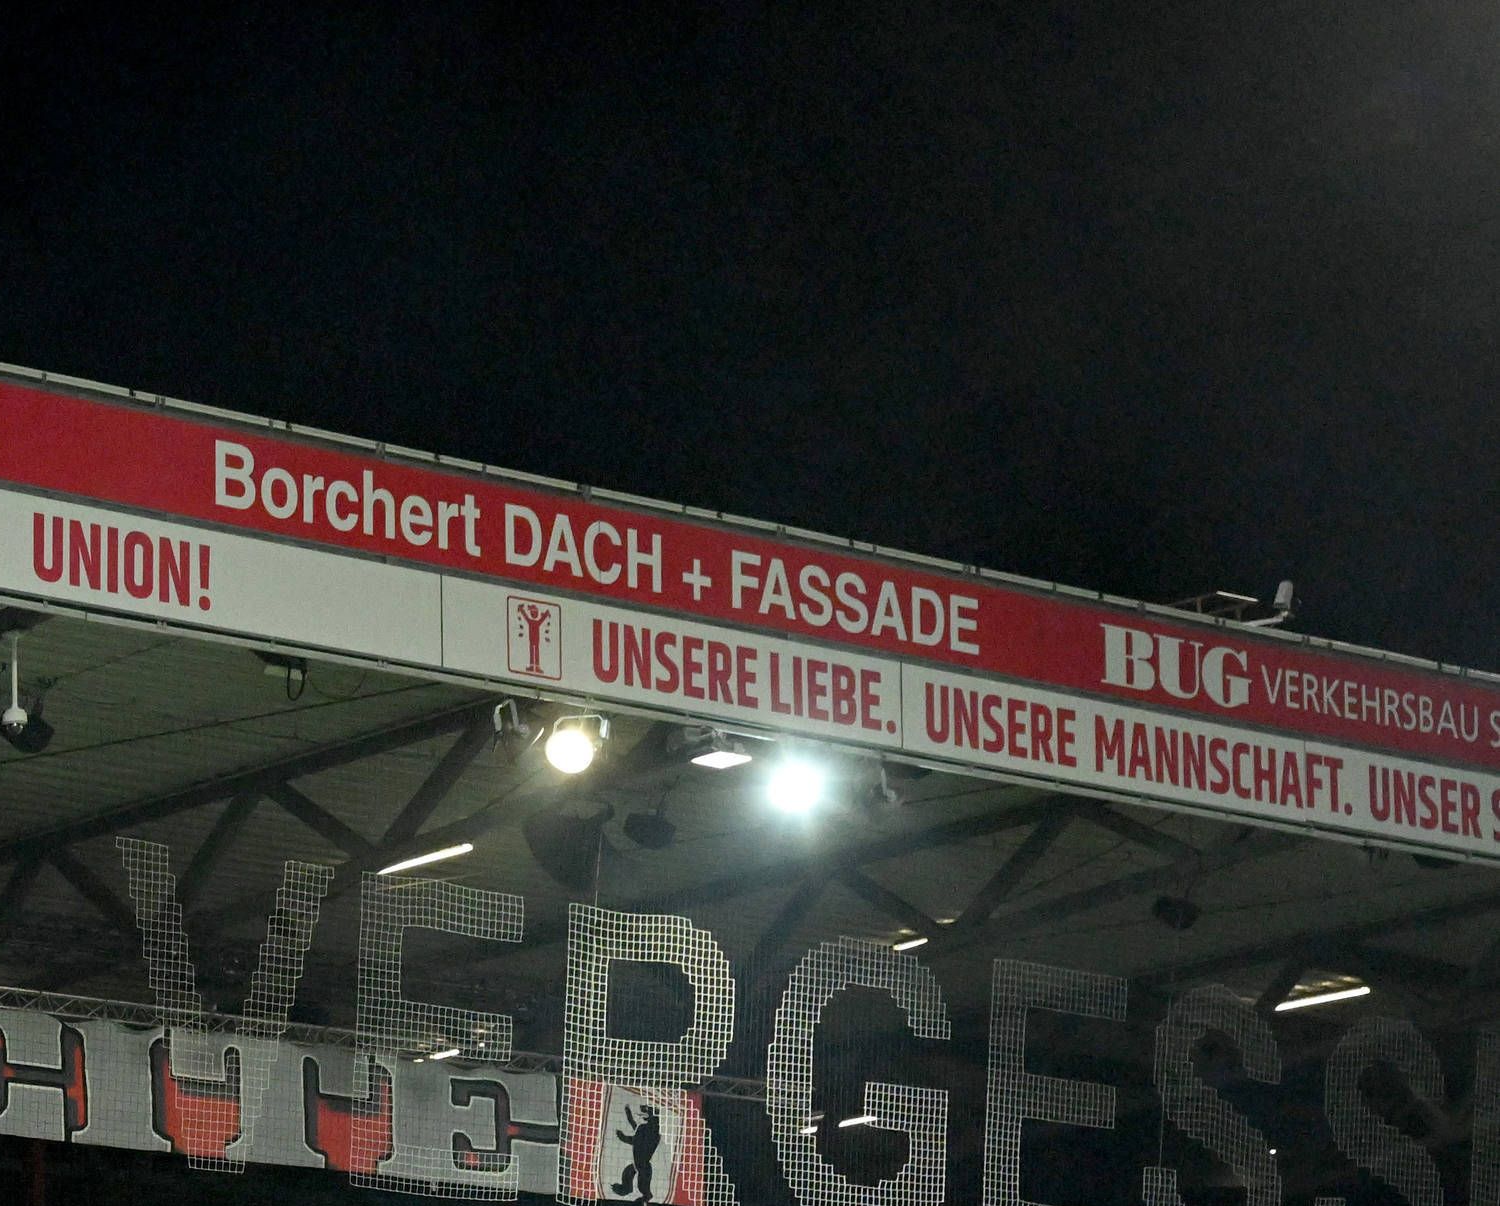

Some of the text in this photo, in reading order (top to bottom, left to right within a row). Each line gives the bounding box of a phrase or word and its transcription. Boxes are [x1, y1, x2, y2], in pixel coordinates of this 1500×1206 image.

[32, 511, 212, 612] UNION!
[214, 438, 980, 656] Borchert DACH + FASSADE
[592, 619, 759, 709] UNSERE
[770, 651, 897, 735] LIEBE.
[924, 681, 1077, 768] UNSERE
[1094, 714, 1353, 817] MANNSCHAFT.
[1368, 764, 1482, 840] UNSER
[1100, 622, 1253, 709] BUG
[1260, 664, 1480, 743] VERKEHRSBAU
